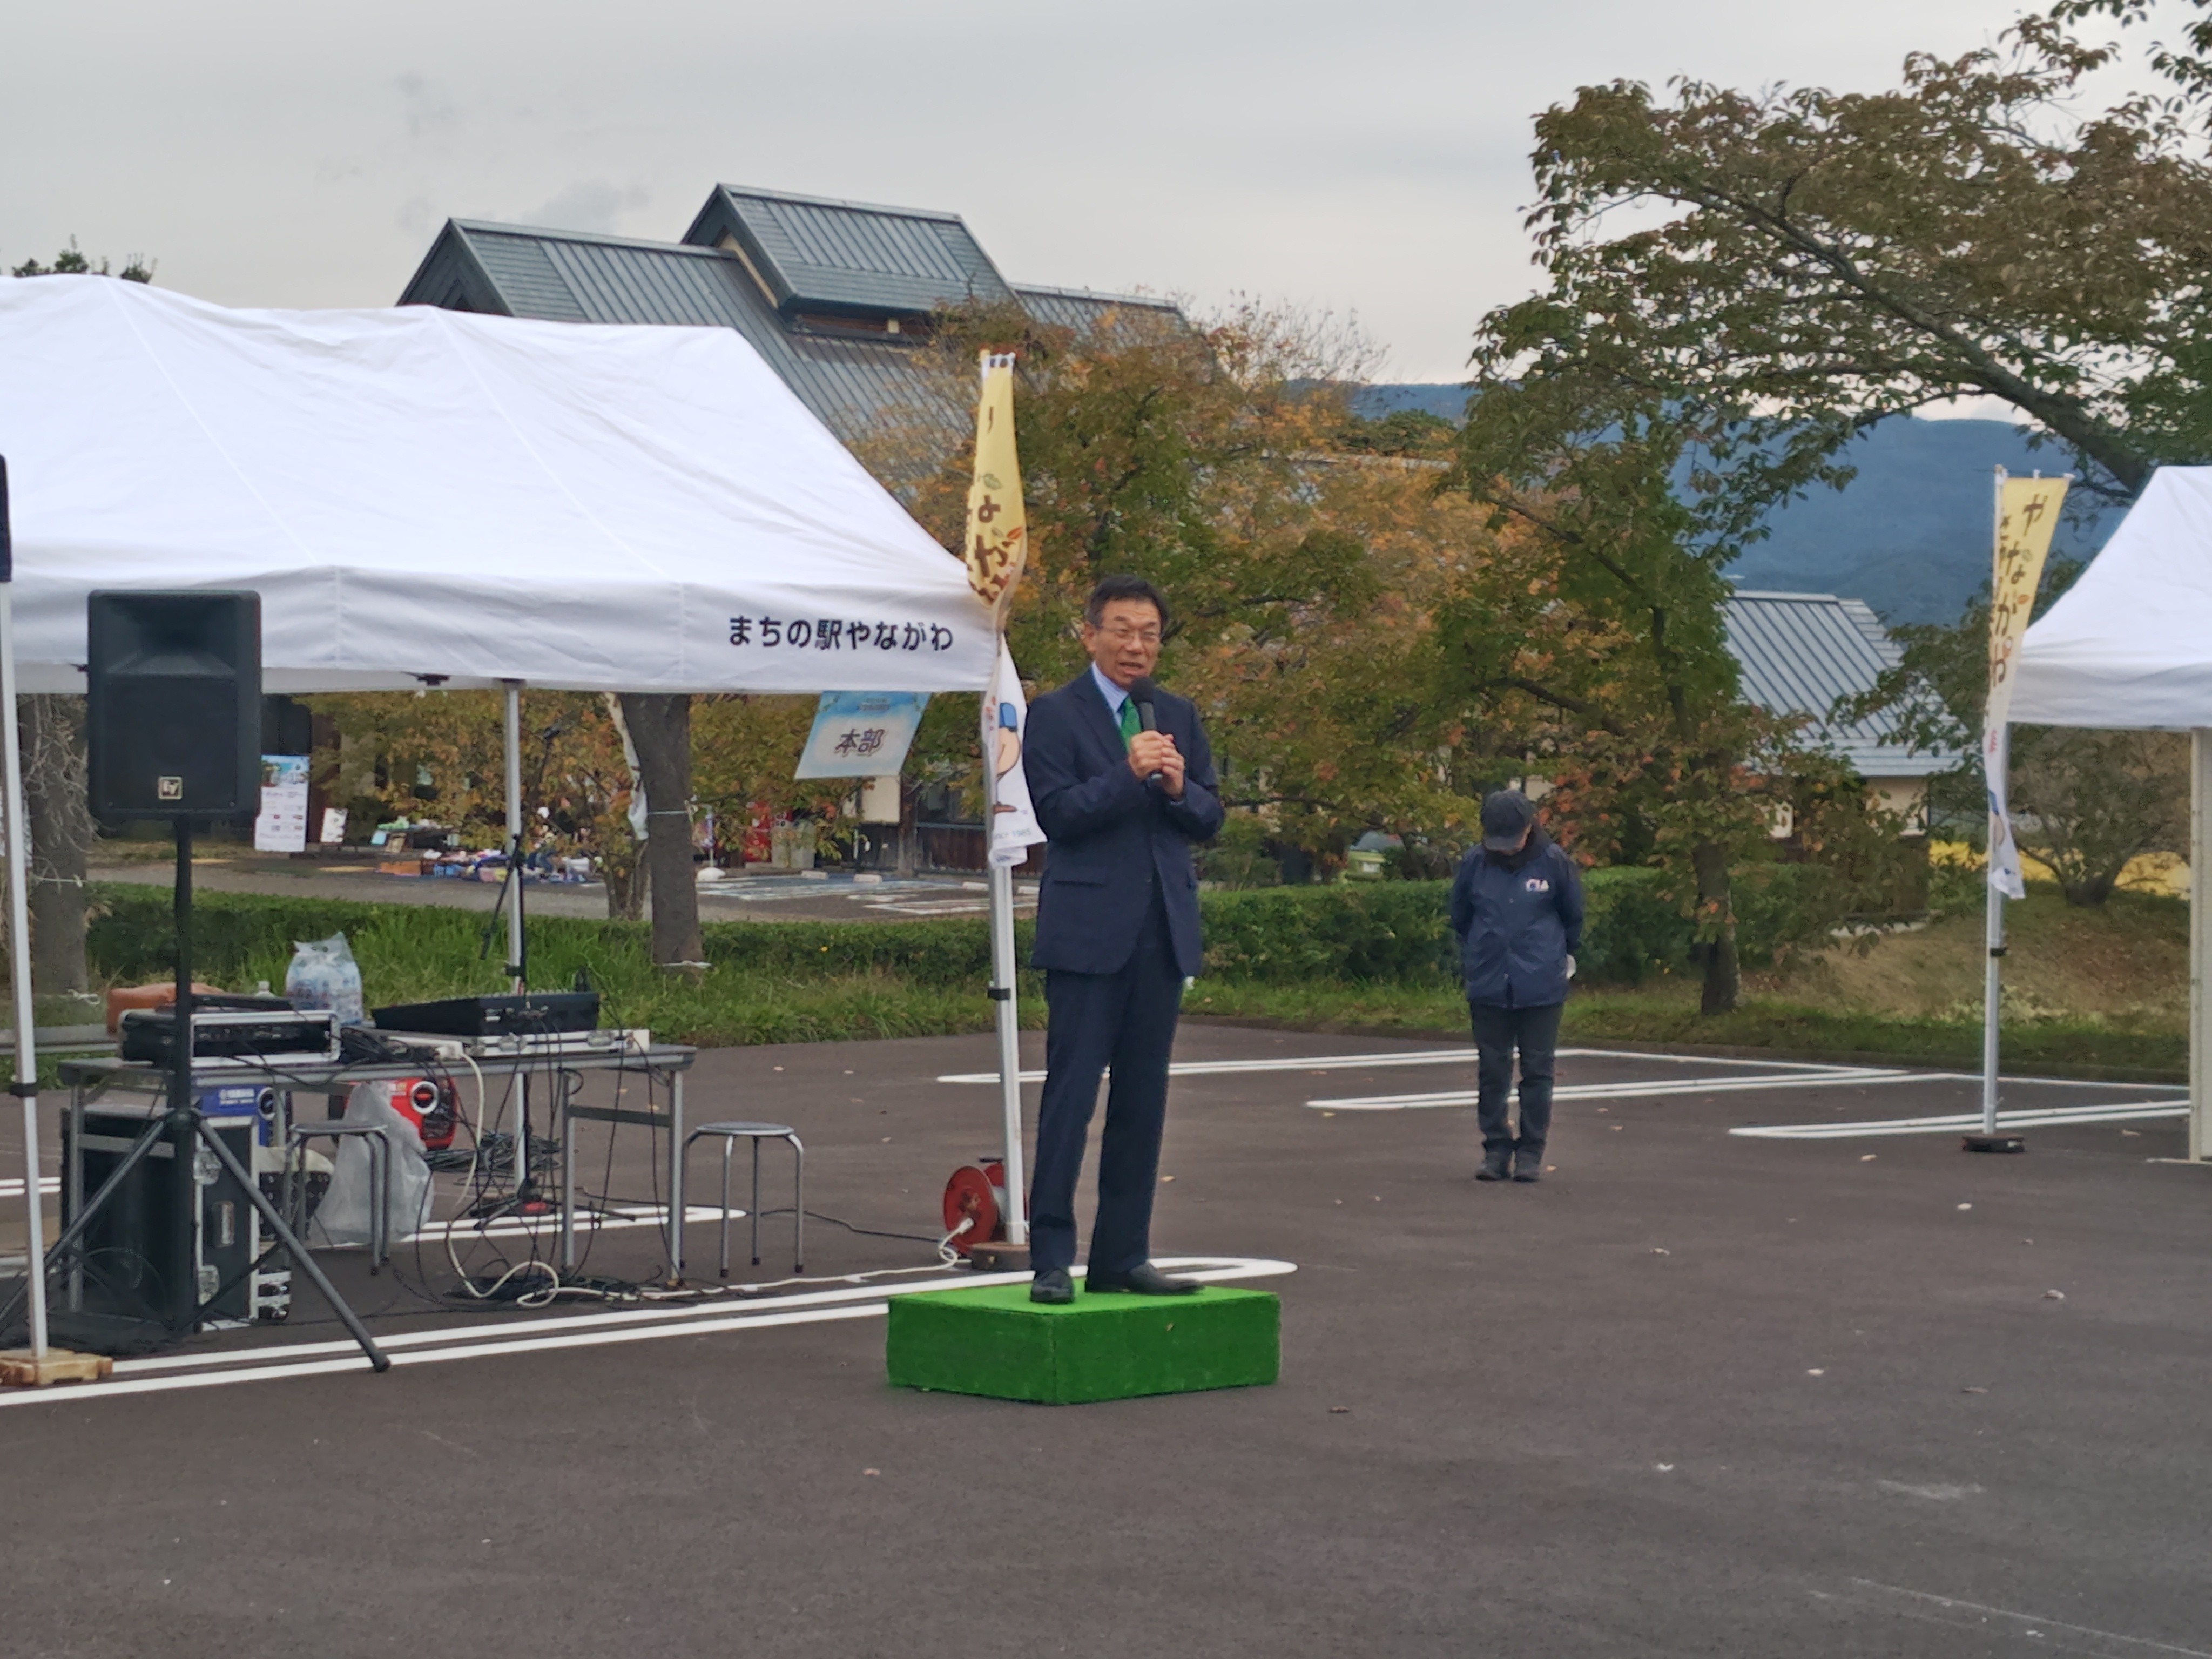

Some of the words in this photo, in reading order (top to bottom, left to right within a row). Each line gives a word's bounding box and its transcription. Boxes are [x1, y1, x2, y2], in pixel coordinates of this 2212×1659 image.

[729, 615, 954, 651] まちの駅やながわ
[834, 729, 886, 754] 本部
